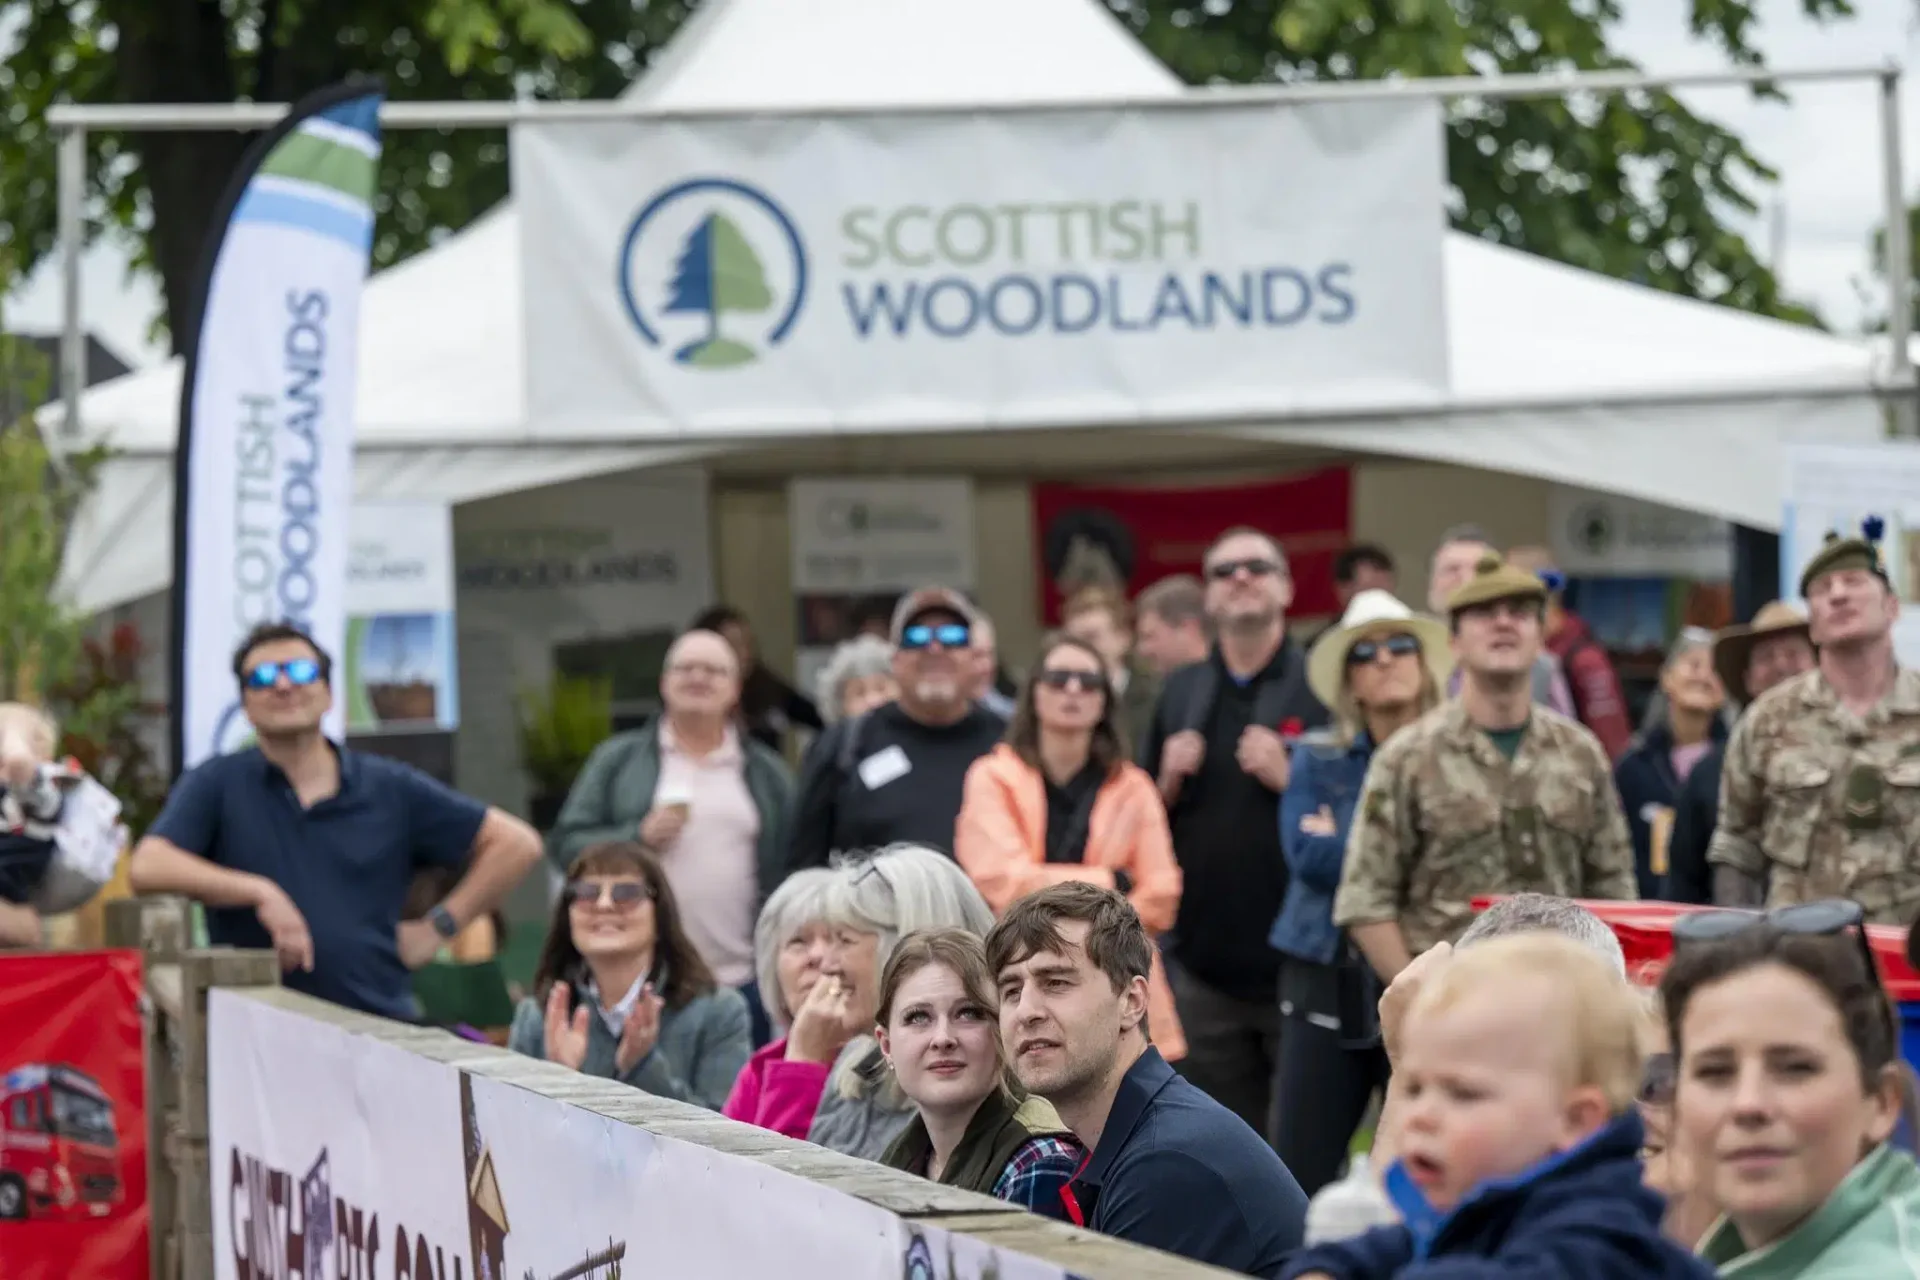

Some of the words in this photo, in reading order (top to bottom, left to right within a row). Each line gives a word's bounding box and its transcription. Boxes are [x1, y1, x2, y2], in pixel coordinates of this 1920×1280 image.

[841, 200, 1199, 269] SCOTTISH
[842, 263, 1356, 340] WOODLANDS
[234, 394, 275, 633] COTTISH
